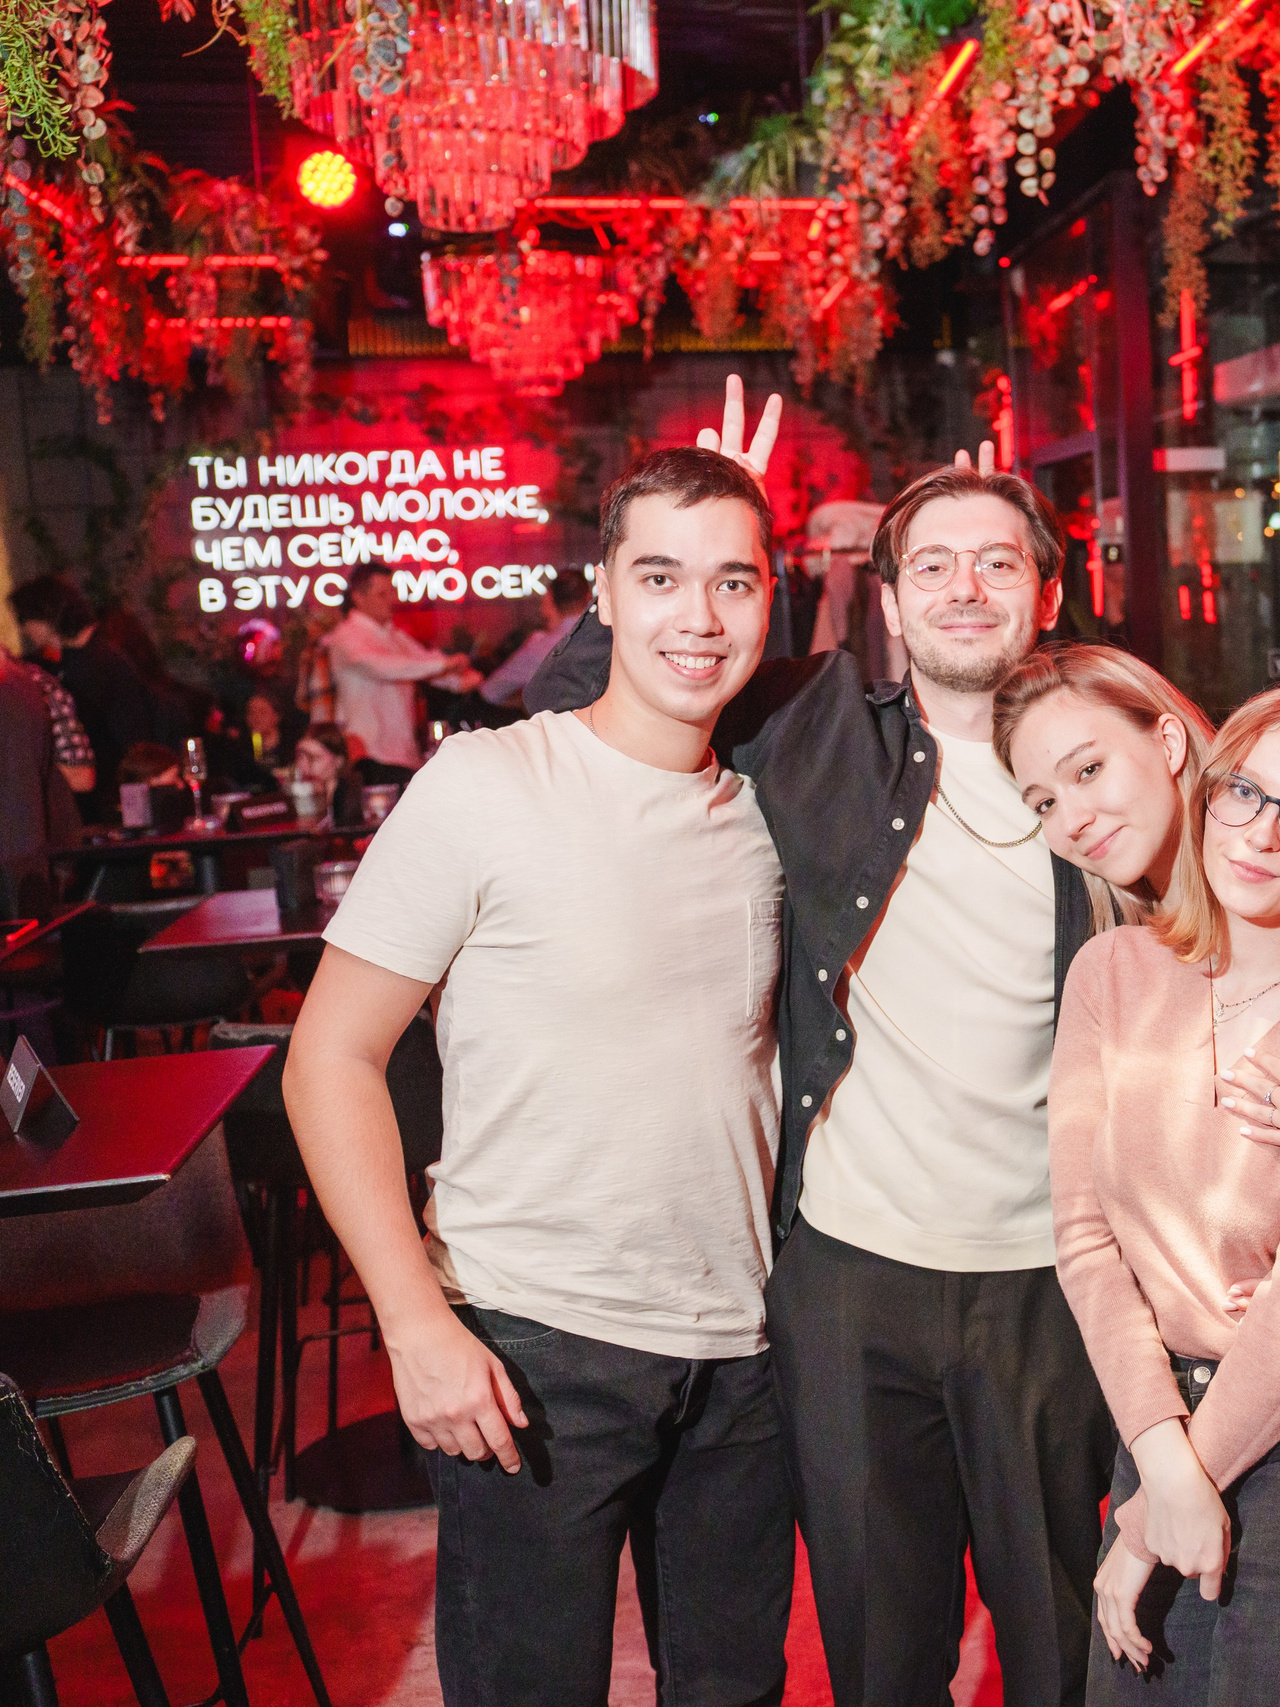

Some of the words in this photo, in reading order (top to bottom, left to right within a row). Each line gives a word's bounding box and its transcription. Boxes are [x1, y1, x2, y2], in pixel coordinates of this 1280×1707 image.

[188, 456, 248, 489] ТЫ
[258, 449, 447, 488] НИКОГДА
[453, 447, 507, 481] НЕ
[191, 493, 354, 533] БУДЕШЬ
[361, 485, 550, 524] МОЛОЖЕ,
[194, 535, 282, 571] ЧЕМ
[287, 525, 460, 568] СЕЙЧАС,
[199, 577, 227, 612] В
[232, 575, 310, 611] ЭТУ
[313, 567, 468, 606] СУЮ
